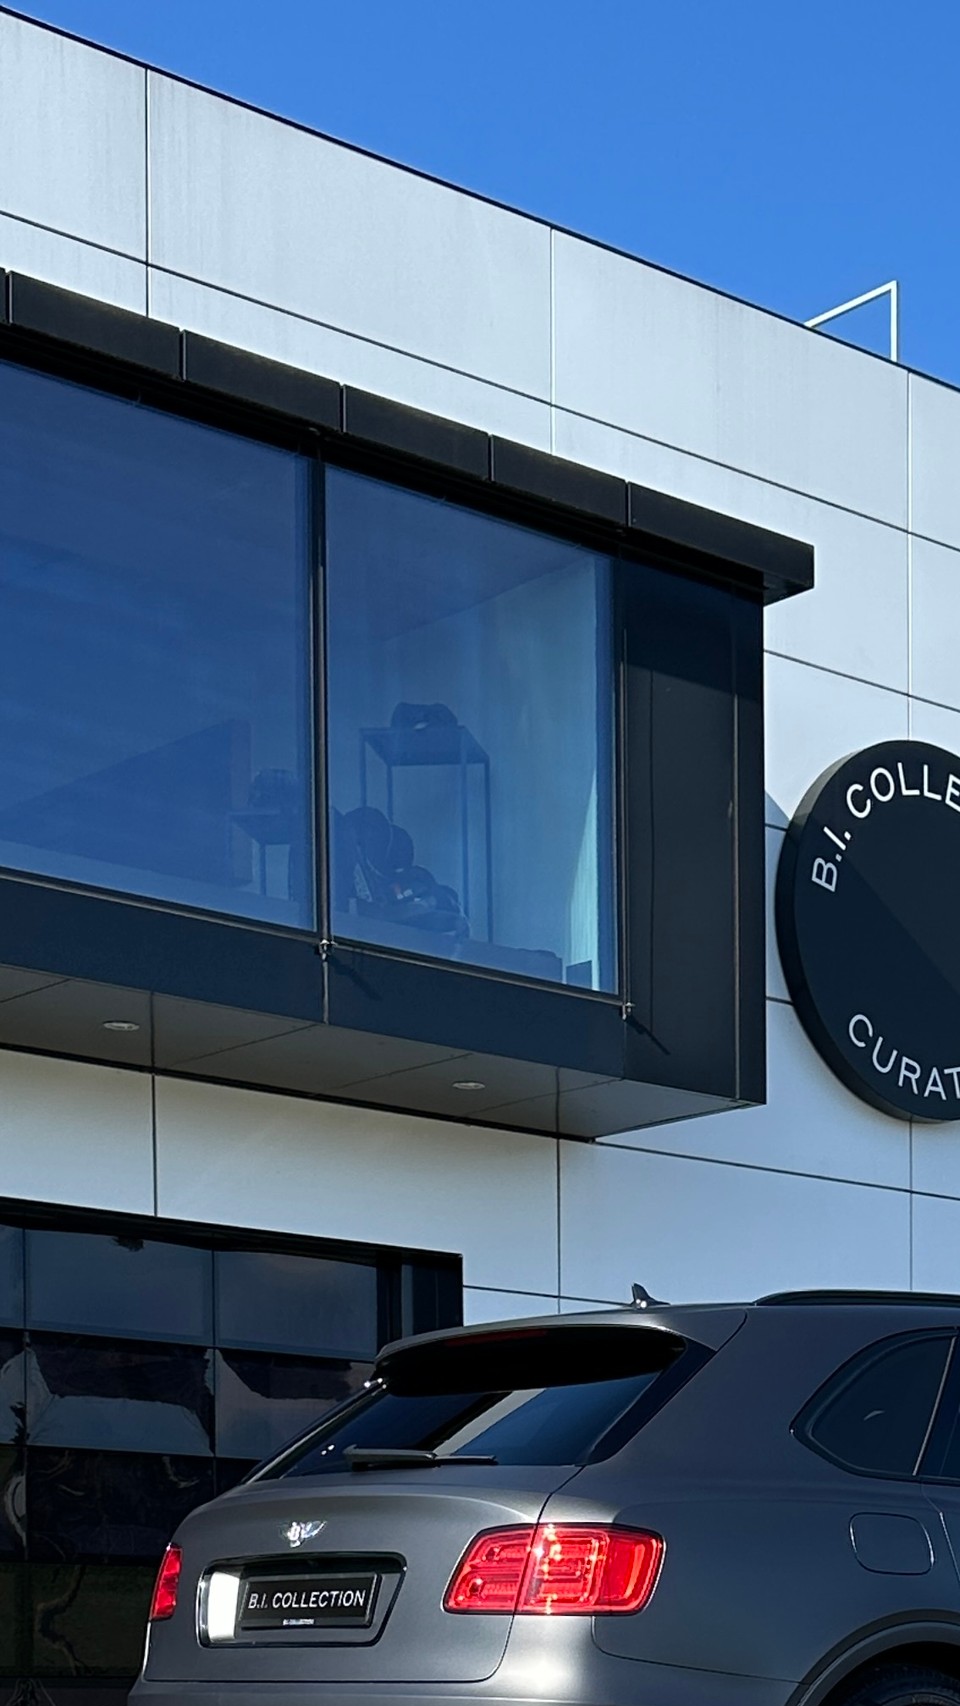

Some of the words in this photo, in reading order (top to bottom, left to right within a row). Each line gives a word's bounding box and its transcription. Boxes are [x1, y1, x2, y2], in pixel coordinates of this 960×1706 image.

[811, 825, 851, 892] B.I.
[248, 1593, 268, 1609] B.I.
[272, 1590, 366, 1608] COLLECTION
